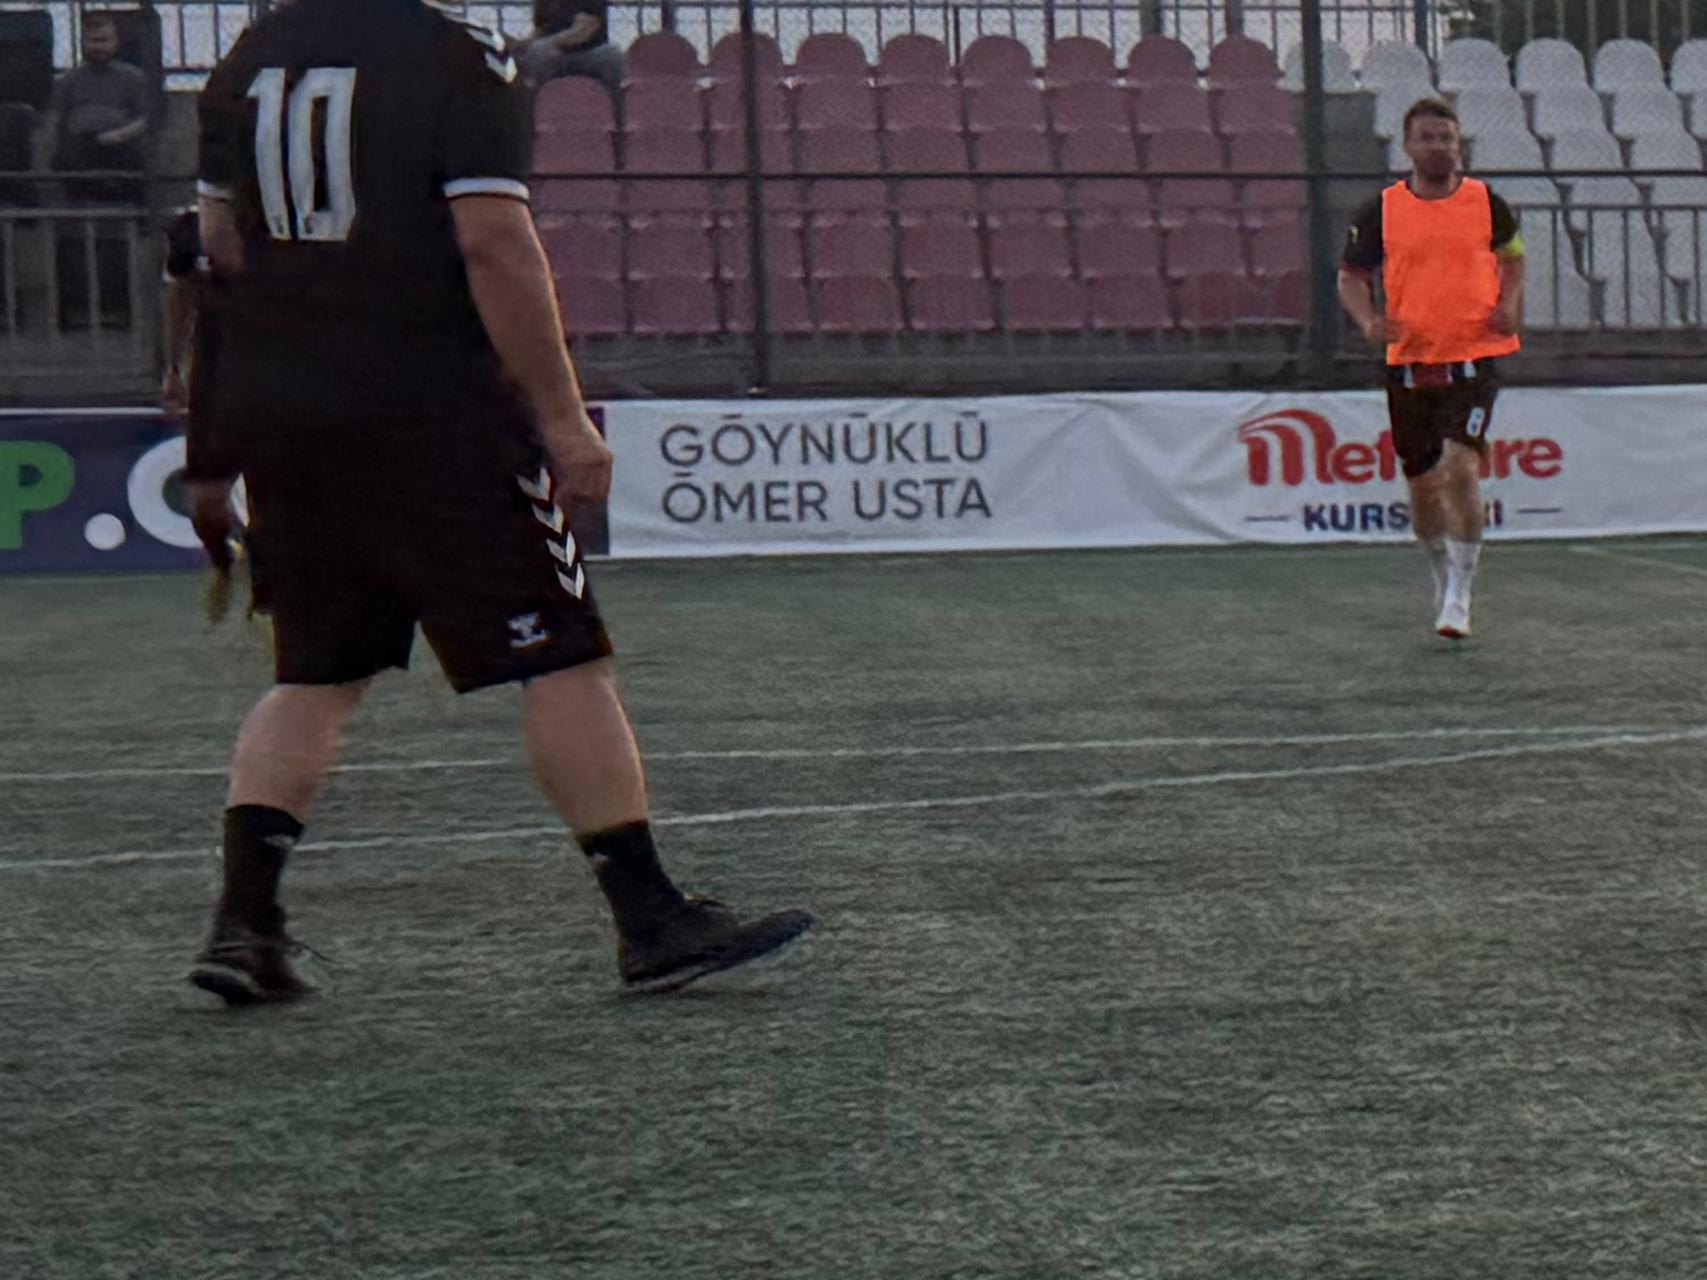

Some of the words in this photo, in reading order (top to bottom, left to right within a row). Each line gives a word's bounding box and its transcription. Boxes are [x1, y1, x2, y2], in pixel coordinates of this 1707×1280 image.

[246, 66, 357, 241] 10
[1466, 406, 1486, 438] 8
[852, 477, 993, 521] USTA
